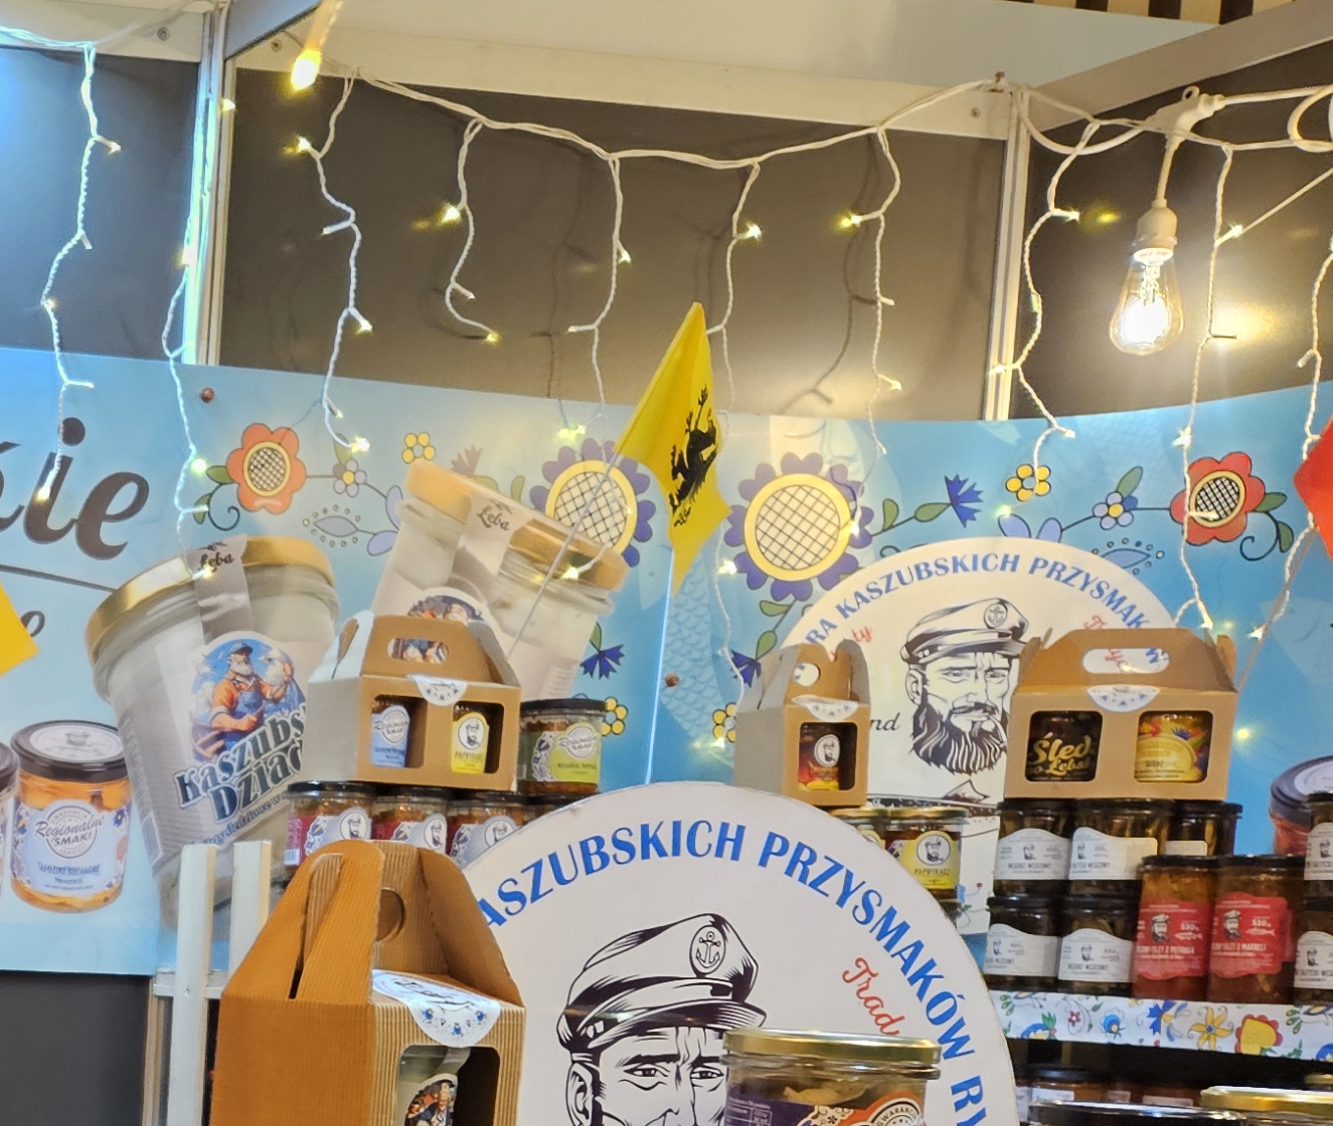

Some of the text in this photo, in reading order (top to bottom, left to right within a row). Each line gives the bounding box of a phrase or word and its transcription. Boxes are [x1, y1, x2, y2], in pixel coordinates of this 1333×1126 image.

[836, 552, 1151, 629] KASZUBSKICH PRZYSMAK
[869, 712, 901, 732] nd
[34, 814, 105, 838] Regionalne
[54, 830, 93, 847] SMAKI
[757, 830, 975, 1062] PRZYSMAKÓW
[842, 956, 901, 1036] Trad
